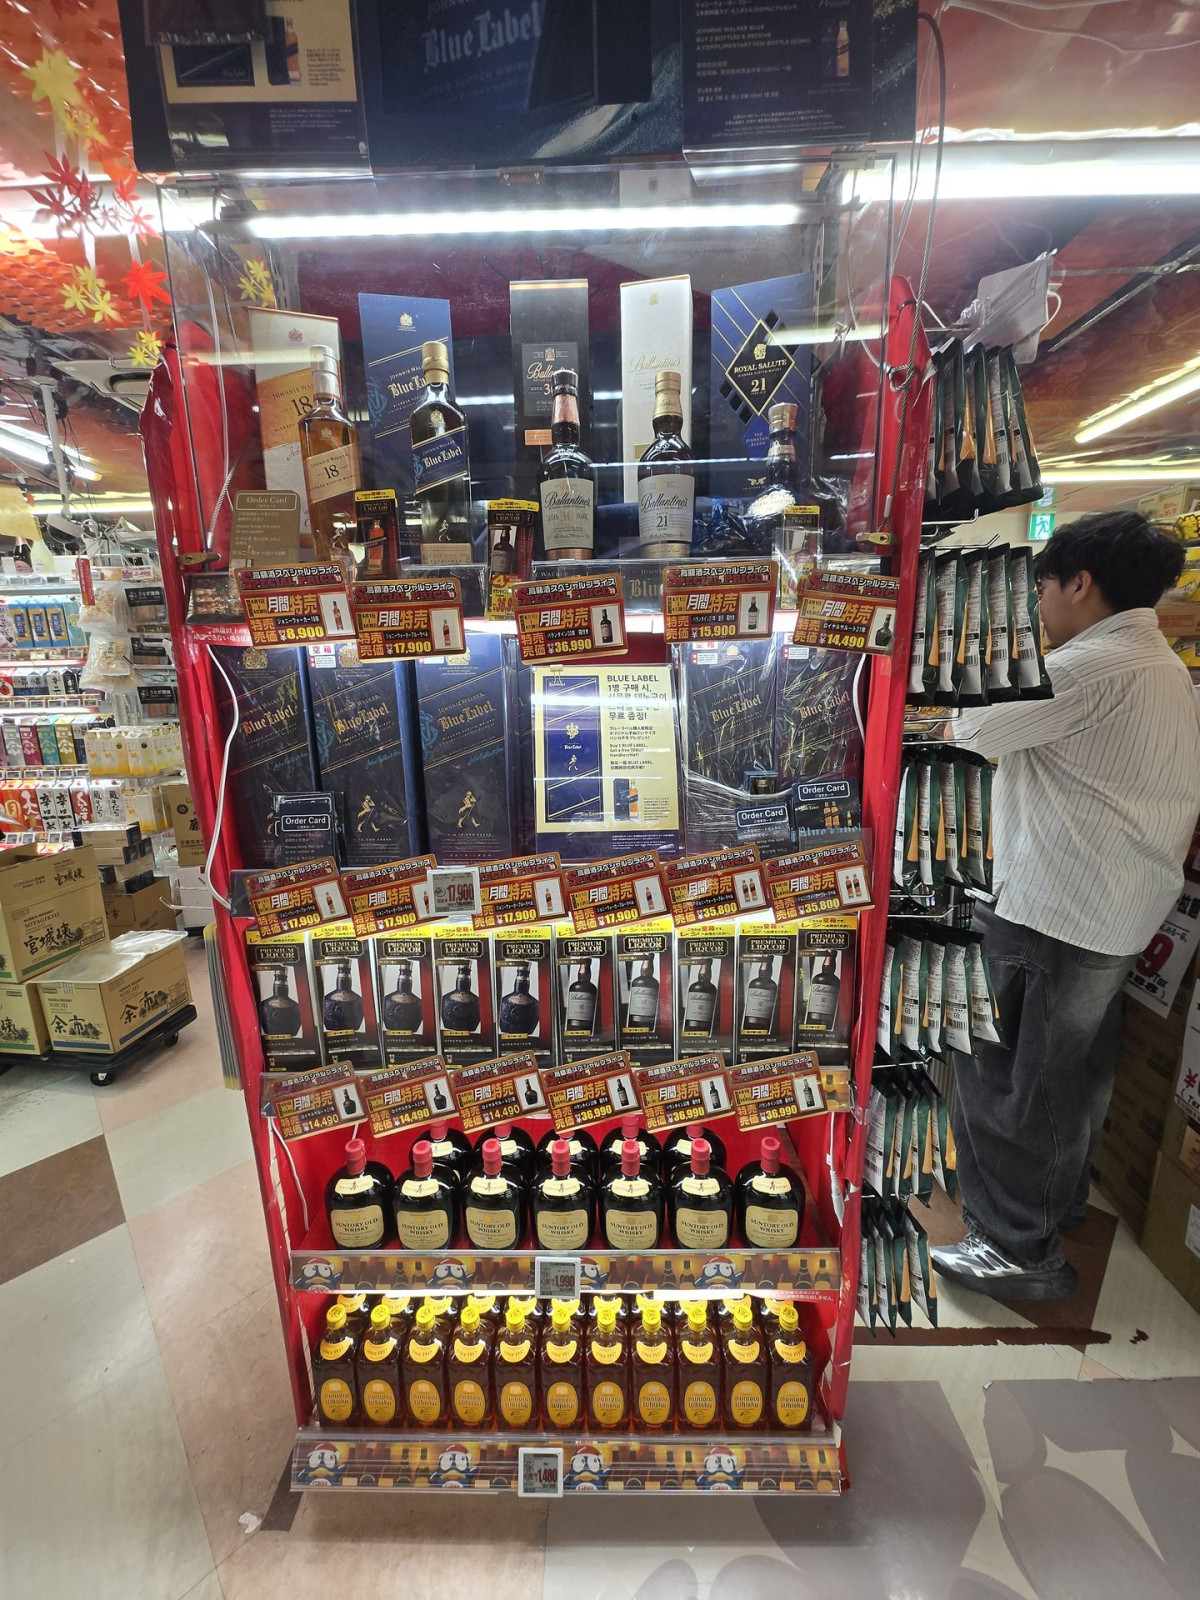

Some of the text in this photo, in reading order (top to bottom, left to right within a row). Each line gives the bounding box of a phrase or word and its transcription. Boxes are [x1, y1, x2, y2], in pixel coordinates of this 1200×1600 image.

[419, 1, 542, 73] Blue Label
[714, 34, 741, 42] BOTTLES
[702, 42, 752, 51] COMPLIMENTARY
[734, 359, 787, 373] ROYAL SALUTE
[389, 370, 411, 381] JOHNNIE
[388, 375, 427, 398] Blue La
[751, 378, 767, 392] 21
[272, 387, 300, 400] JOHNNIE
[292, 395, 314, 417] 18
[330, 453, 349, 462] WALKER
[422, 446, 463, 469] Blue Label
[324, 464, 340, 479] 18
[544, 492, 591, 509] Ballantine's
[641, 492, 689, 512] Ballantine's
[656, 515, 669, 528] 21
[268, 594, 317, 614] 月間特売
[687, 593, 739, 612] 月間特売
[378, 609, 428, 630] 月間特売
[540, 607, 589, 628] 月間特売
[821, 600, 874, 625] 月間特売
[251, 618, 275, 631] 特売
[666, 616, 689, 627] 特売
[253, 630, 278, 643] 売価
[359, 632, 382, 644] 特売
[521, 633, 545, 645] 特売
[667, 628, 689, 640] 売価
[361, 644, 384, 656] 売価
[523, 645, 546, 657] 売価
[608, 684, 652, 692] 1병 구매 시,
[461, 692, 486, 704] WALKER
[800, 691, 850, 720] Blue Label
[710, 695, 762, 721] Blue Label
[242, 704, 297, 735] Blue Label
[334, 703, 390, 734] Blue Label
[438, 701, 496, 731] Blue Label
[609, 712, 647, 720] 무료 증정!
[802, 783, 845, 795] Order Card
[285, 817, 326, 826] Order Card
[741, 809, 783, 820] Order Card
[688, 875, 732, 895] 月間特売
[790, 871, 834, 892] 月間特売
[271, 887, 313, 909] 月間特売
[368, 886, 411, 906] 月間特売
[489, 882, 532, 900] 月間特売
[589, 881, 632, 902] 月間特売
[25, 912, 59, 928] MIYAGIKYO
[24, 922, 75, 955] 宮城峡
[324, 940, 358, 949] PREMIUM
[568, 940, 602, 948] PREMIUM
[324, 946, 359, 954] LIQUOR
[568, 946, 603, 954] LIQUOR
[384, 1084, 424, 1105] 月間特売
[474, 1079, 514, 1101] 月間特売
[566, 1080, 606, 1101] 月間特売
[659, 1082, 699, 1101] 月間特売
[752, 1080, 792, 1099] 月間特売
[293, 1089, 332, 1110] 月間特売
[336, 1217, 379, 1229] SUNTORY OLD
[344, 1225, 369, 1233] WHISKY
[611, 1223, 638, 1231] SUNTORY
